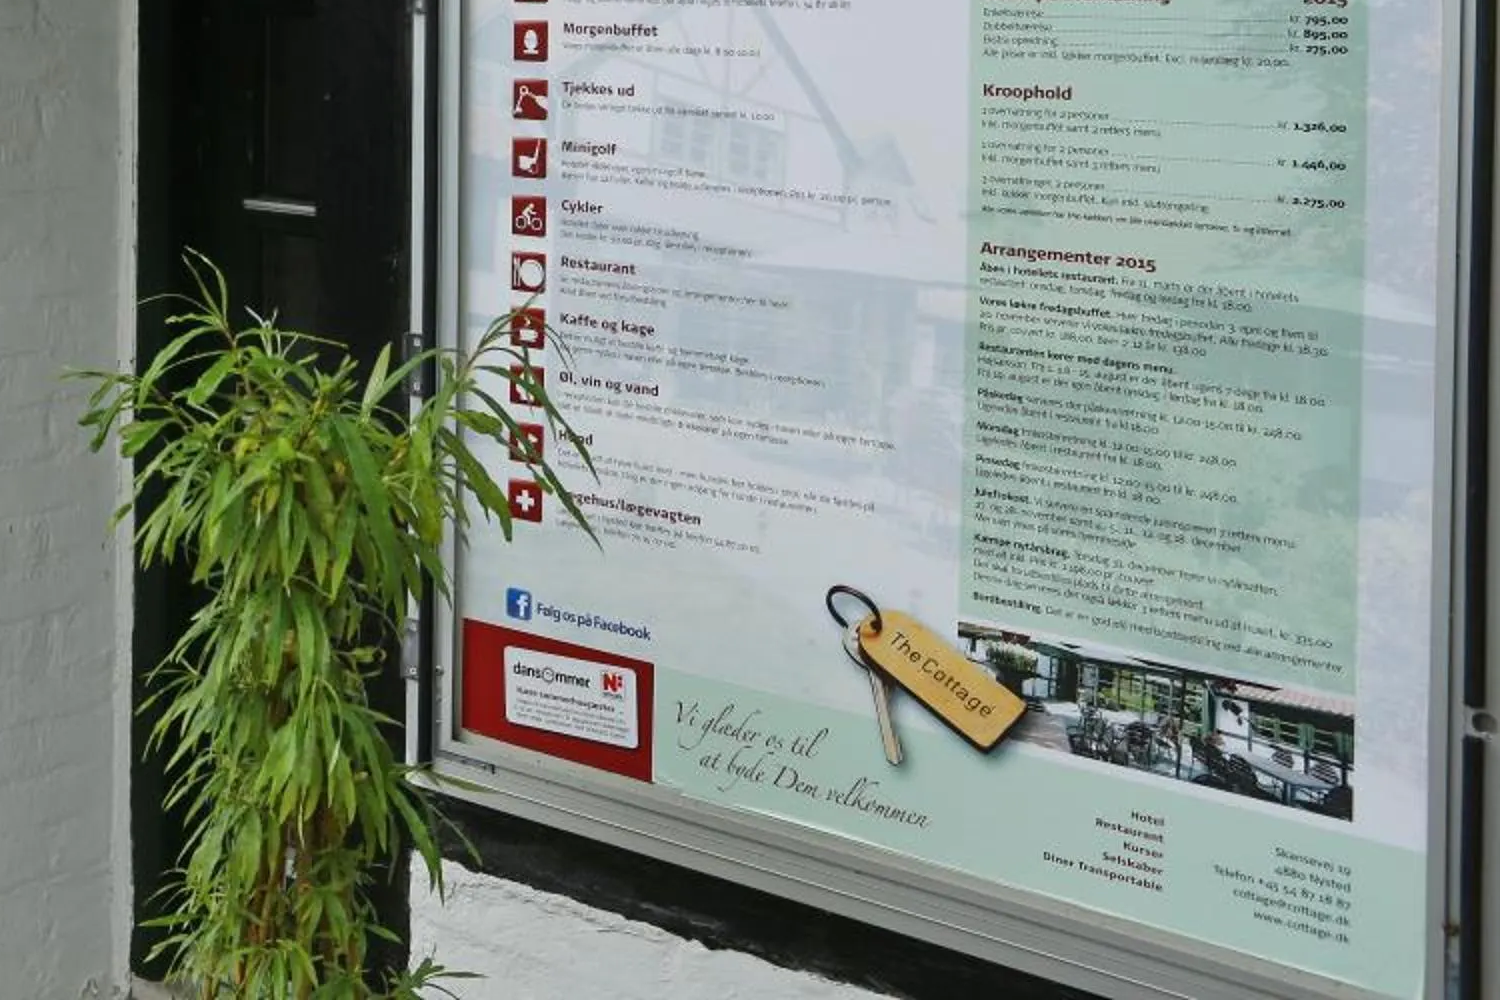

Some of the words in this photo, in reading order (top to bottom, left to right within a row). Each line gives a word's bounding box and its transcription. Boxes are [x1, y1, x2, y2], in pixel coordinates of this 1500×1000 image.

[563, 22, 660, 39] Morgenbuffet
[561, 81, 614, 98] Tjekkes
[617, 83, 636, 97] ud
[982, 83, 1073, 101] Kroophold
[561, 141, 618, 158] Minigolf
[561, 199, 605, 215] Cykler
[560, 256, 638, 276] Restaurant
[980, 241, 1112, 266] Arrangementer
[1115, 255, 1157, 273] 2015
[560, 312, 598, 329] Kaffe
[601, 320, 618, 335] og
[621, 319, 656, 337] kage
[581, 375, 601, 390] vin
[605, 381, 622, 395] og
[624, 382, 659, 398] vand
[558, 430, 593, 446] Hnd
[559, 489, 702, 526] gehus/lægevagten
[536, 602, 561, 622] Følg
[563, 612, 576, 623] os
[577, 612, 592, 628] på
[593, 615, 652, 641] Facebook
[888, 631, 922, 663] The
[921, 656, 993, 718] Cottage
[677, 700, 701, 727] Vi
[764, 734, 783, 749] os
[791, 726, 829, 759] til
[699, 754, 722, 771] at
[772, 765, 820, 801] Dem
[824, 776, 929, 828] velkommen
[1095, 817, 1164, 843] Restaurant
[1131, 810, 1165, 827] Hotel
[1123, 841, 1164, 859] Kurser
[1102, 851, 1164, 875] Selskaber
[1078, 861, 1163, 891] Transportable
